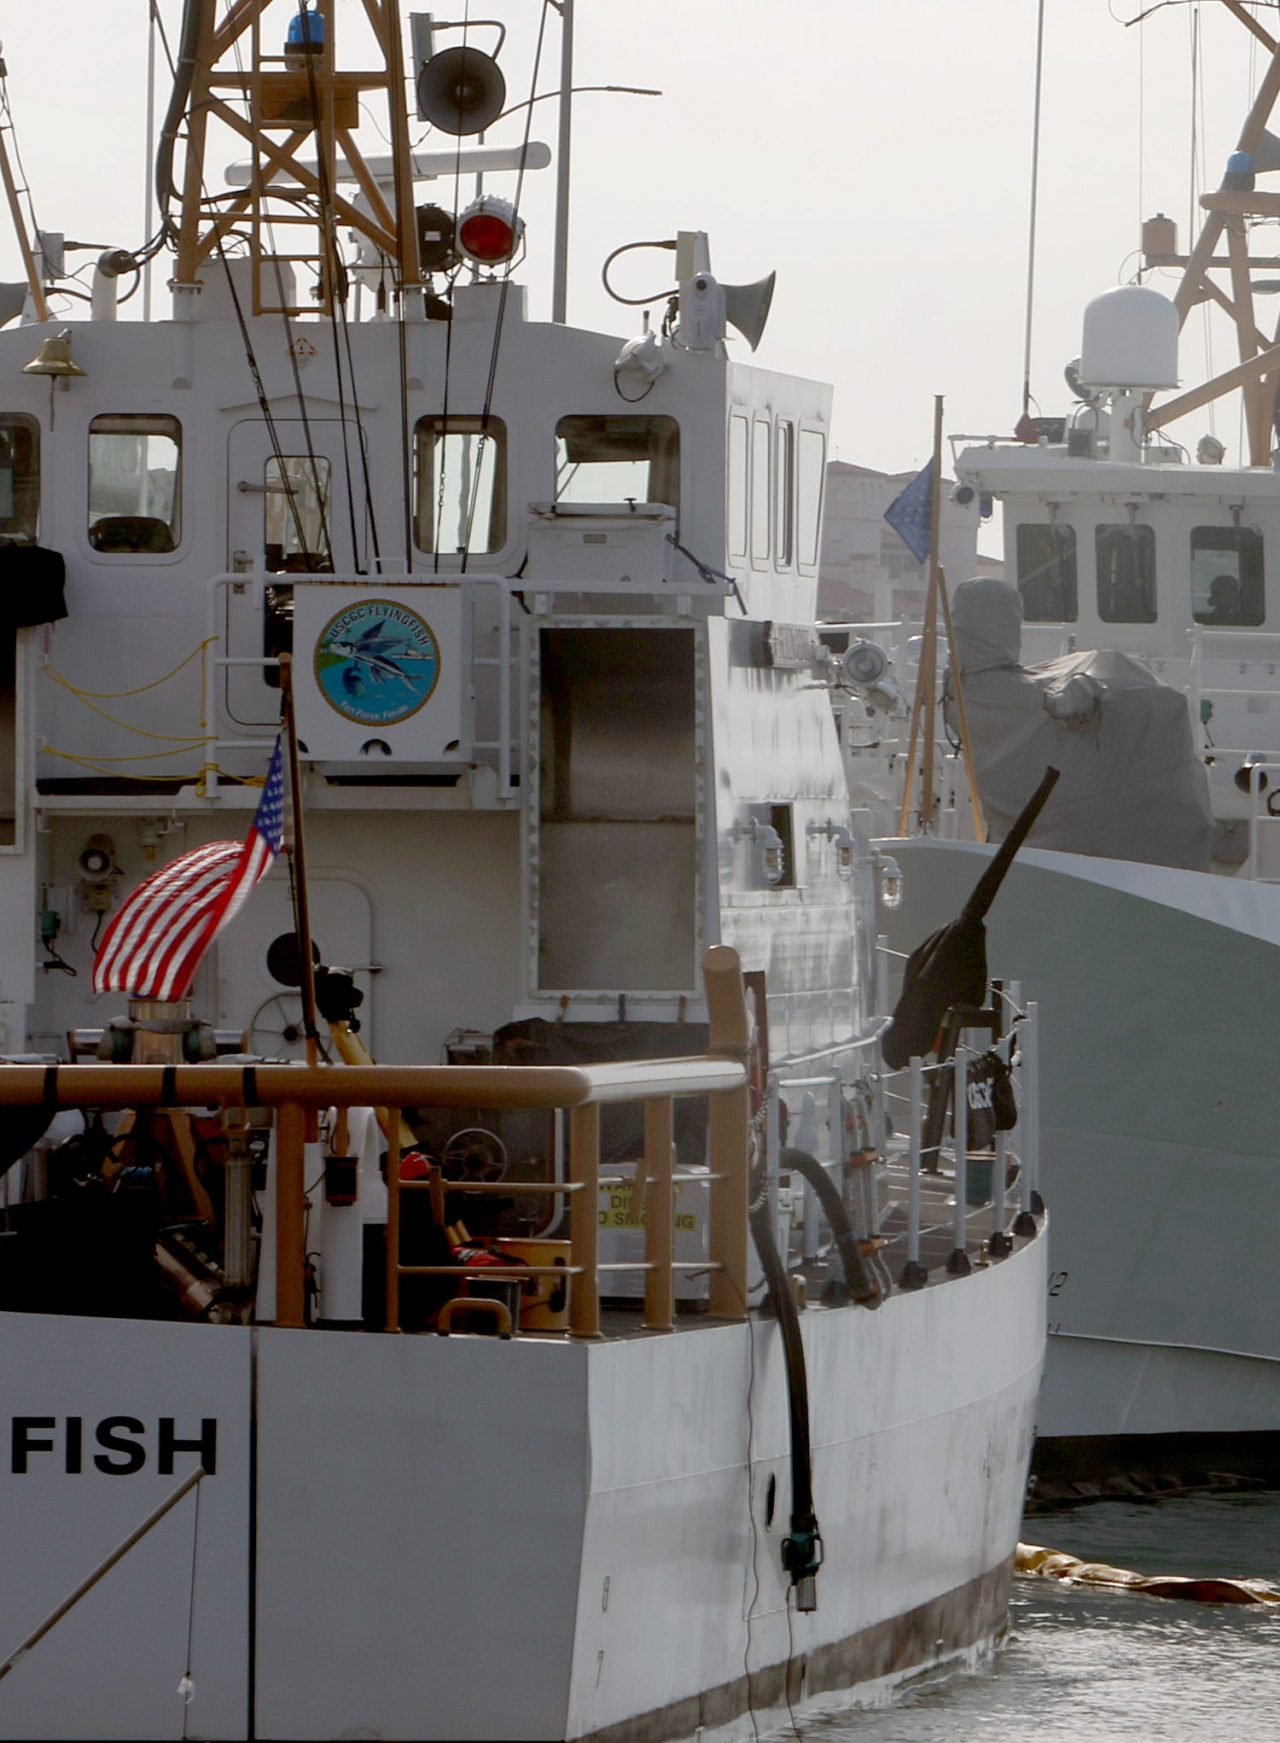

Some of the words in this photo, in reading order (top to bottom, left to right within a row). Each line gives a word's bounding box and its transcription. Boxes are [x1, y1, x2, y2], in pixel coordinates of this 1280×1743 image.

[330, 608, 365, 638] USCGC
[369, 606, 429, 645] FLYINGFISH
[11, 1416, 217, 1476] FISH
